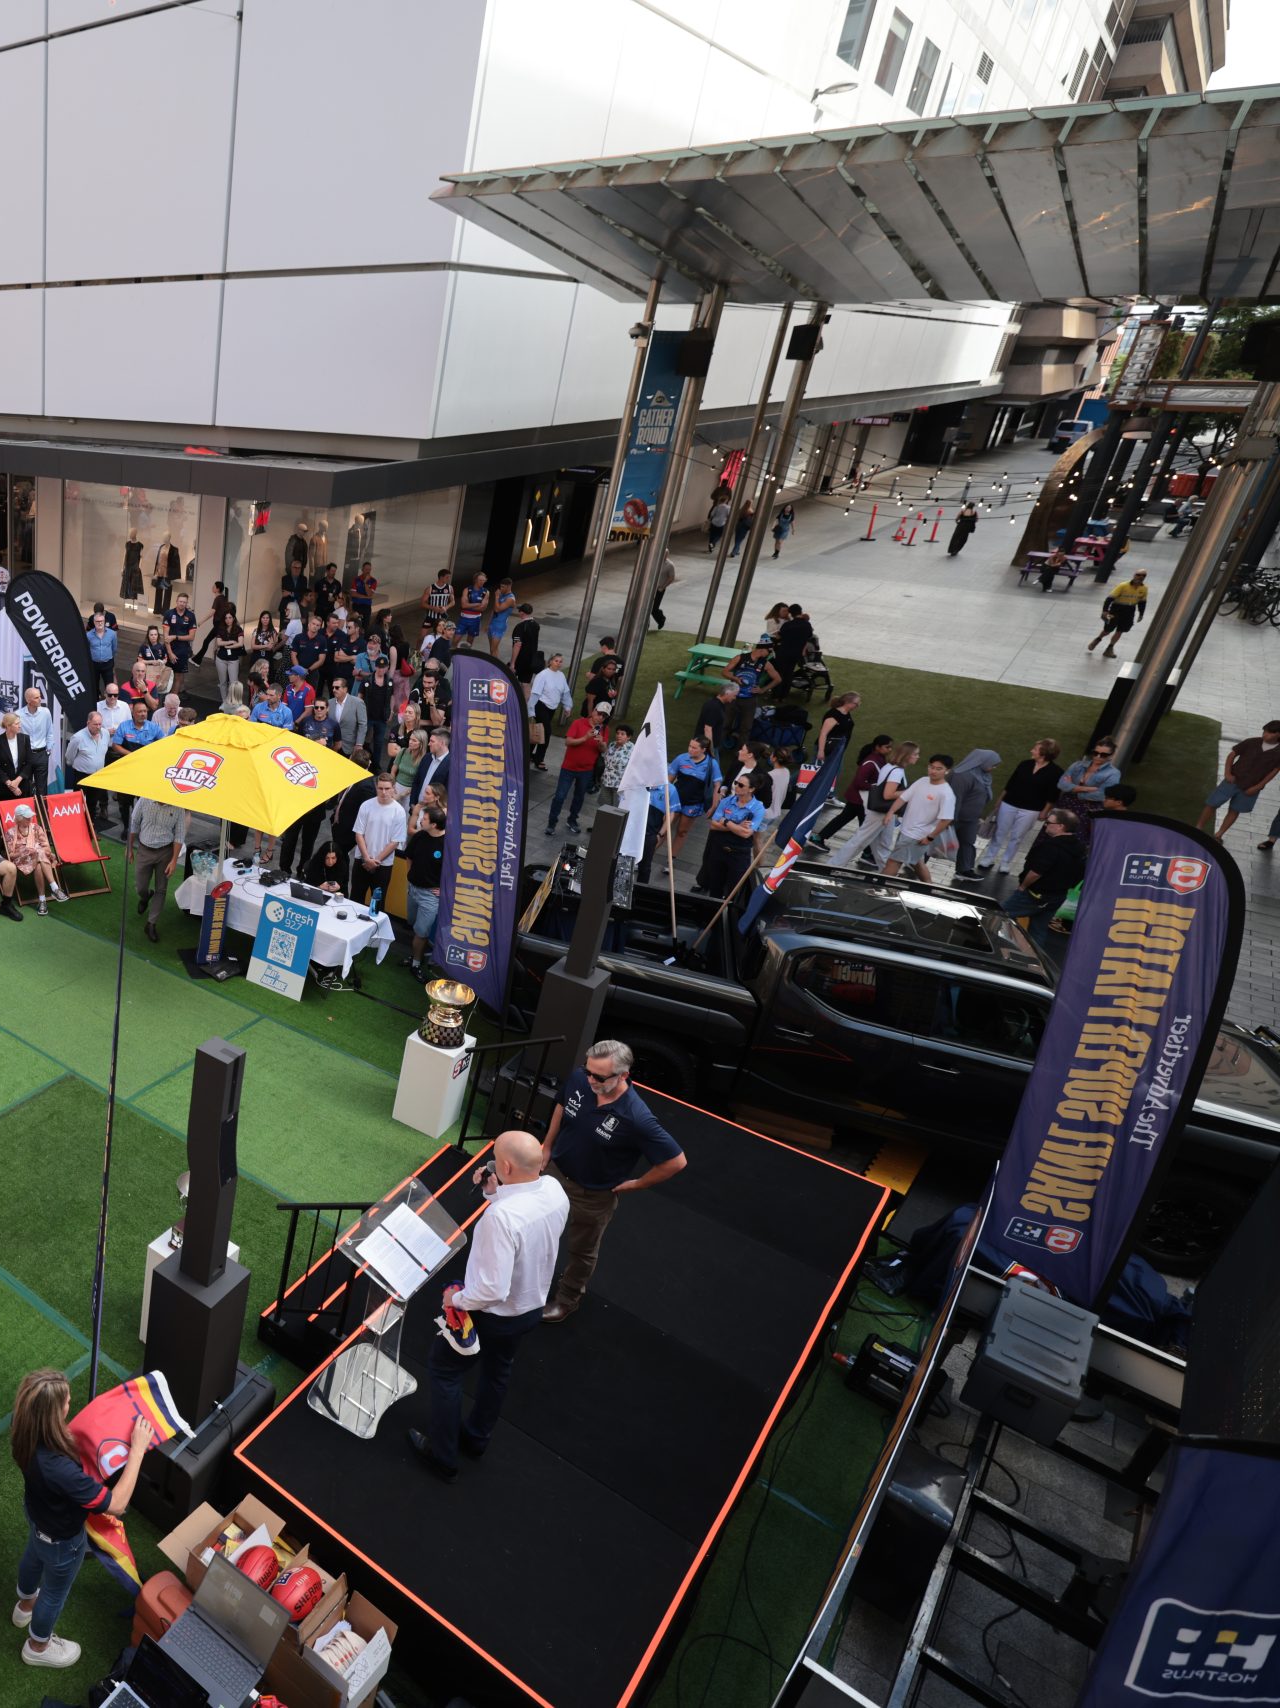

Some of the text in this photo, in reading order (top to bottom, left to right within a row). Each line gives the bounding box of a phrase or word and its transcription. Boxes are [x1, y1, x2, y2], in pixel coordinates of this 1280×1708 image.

[638, 408, 674, 427] GATHER
[635, 427, 670, 445] ROUND
[14, 591, 86, 699] POWERADE
[165, 766, 218, 790] SANFL
[284, 761, 319, 786] SANFL
[53, 803, 81, 818] AAMI
[286, 907, 314, 927] fresh
